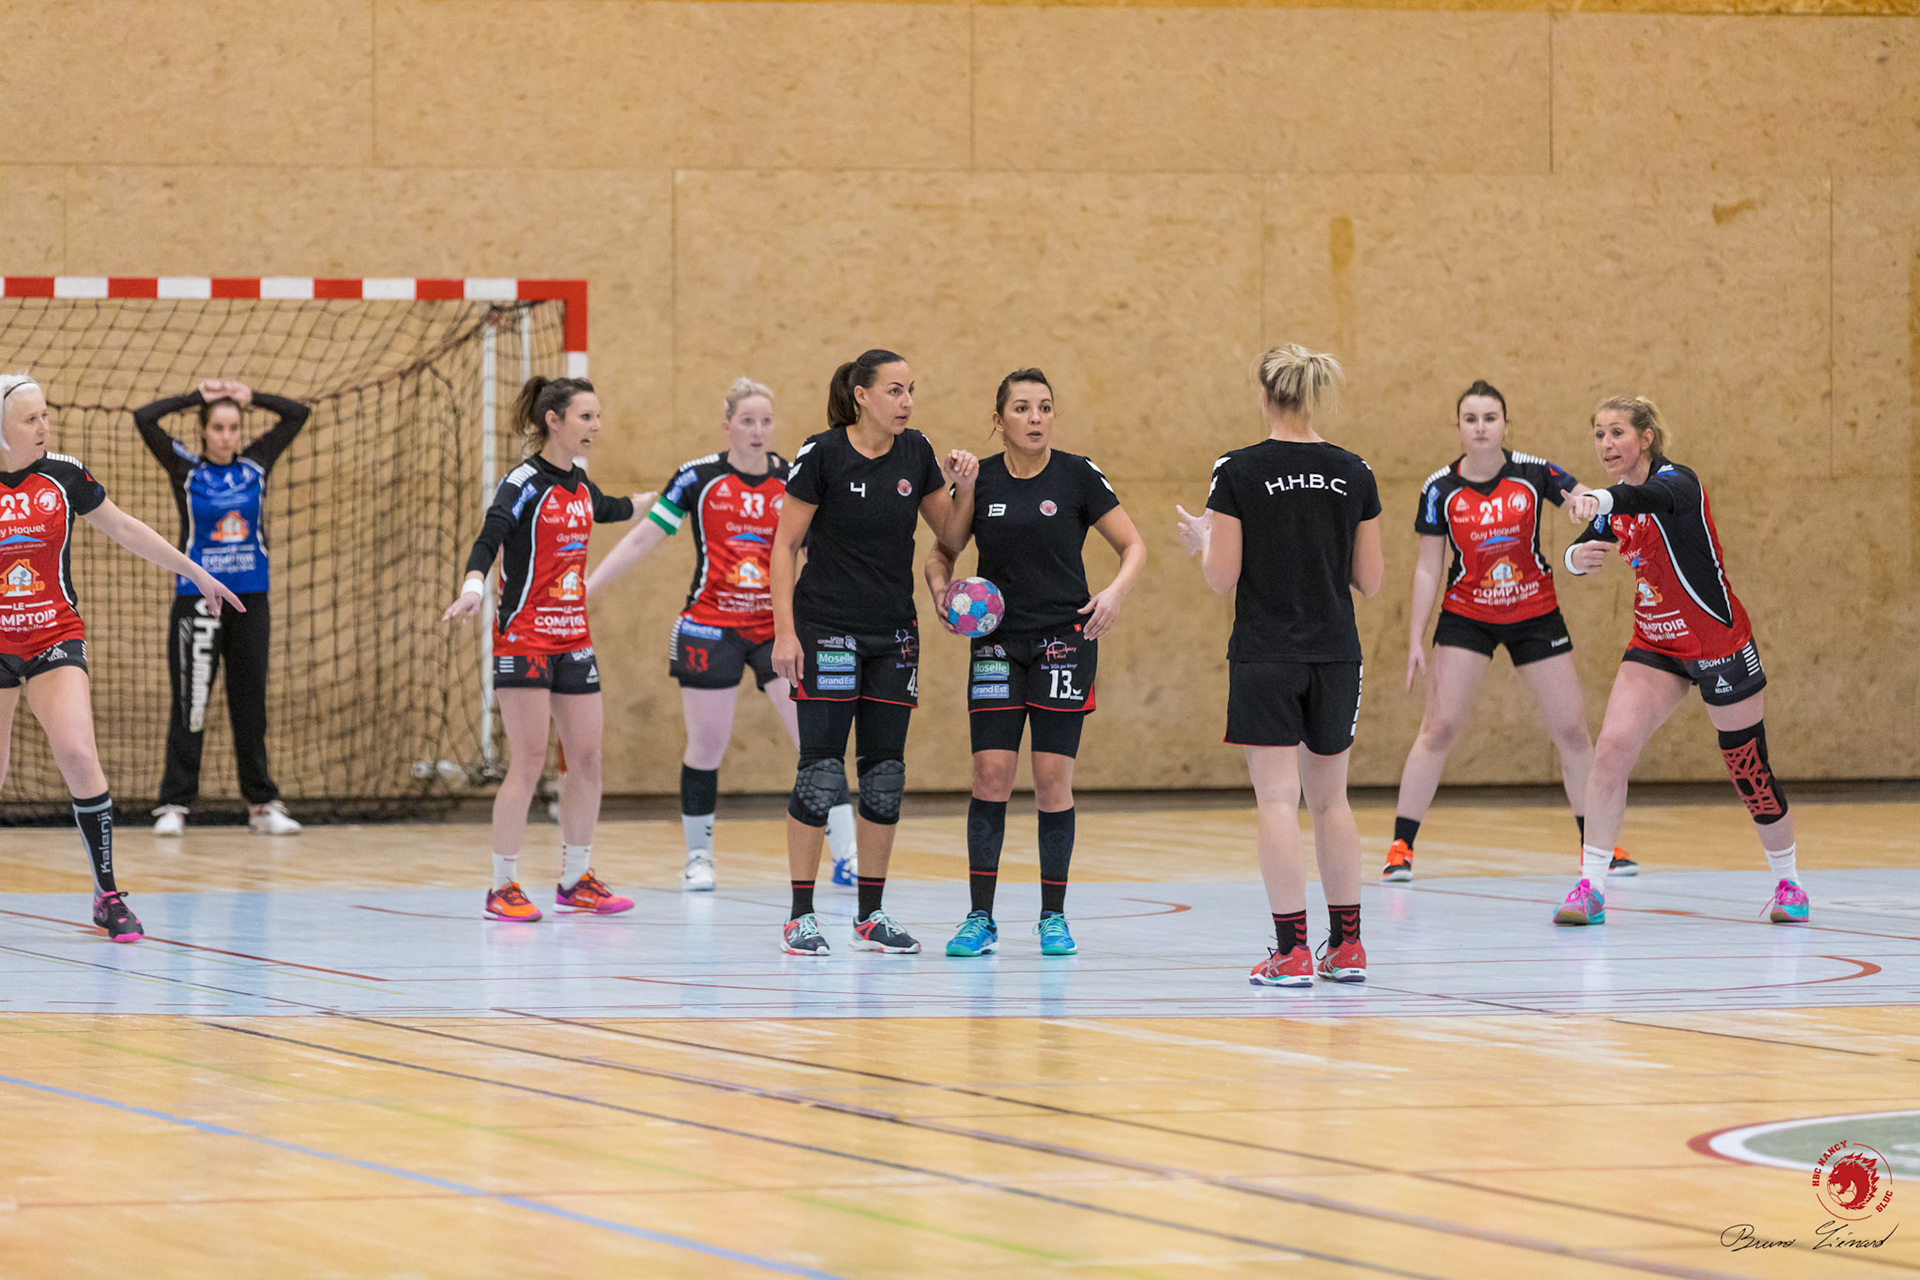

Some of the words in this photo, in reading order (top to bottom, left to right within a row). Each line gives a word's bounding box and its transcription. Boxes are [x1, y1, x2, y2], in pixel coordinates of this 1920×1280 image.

[850, 482, 866, 498] 4
[1264, 473, 1348, 496] H.H.B.C.
[0, 493, 30, 521] 23
[740, 491, 765, 519] 33
[987, 503, 1007, 517] 13
[8, 523, 46, 535] Hoquet
[1470, 531, 1488, 541] Guy
[1489, 524, 1520, 537] Hoquet
[12, 602, 25, 611] LE
[0, 608, 58, 626] MPTOIR
[685, 645, 708, 673] 33
[818, 653, 854, 664] Moselle
[1049, 670, 1073, 699] 13
[1715, 686, 1733, 694] SELECT
[96, 811, 112, 873] Kalenji
